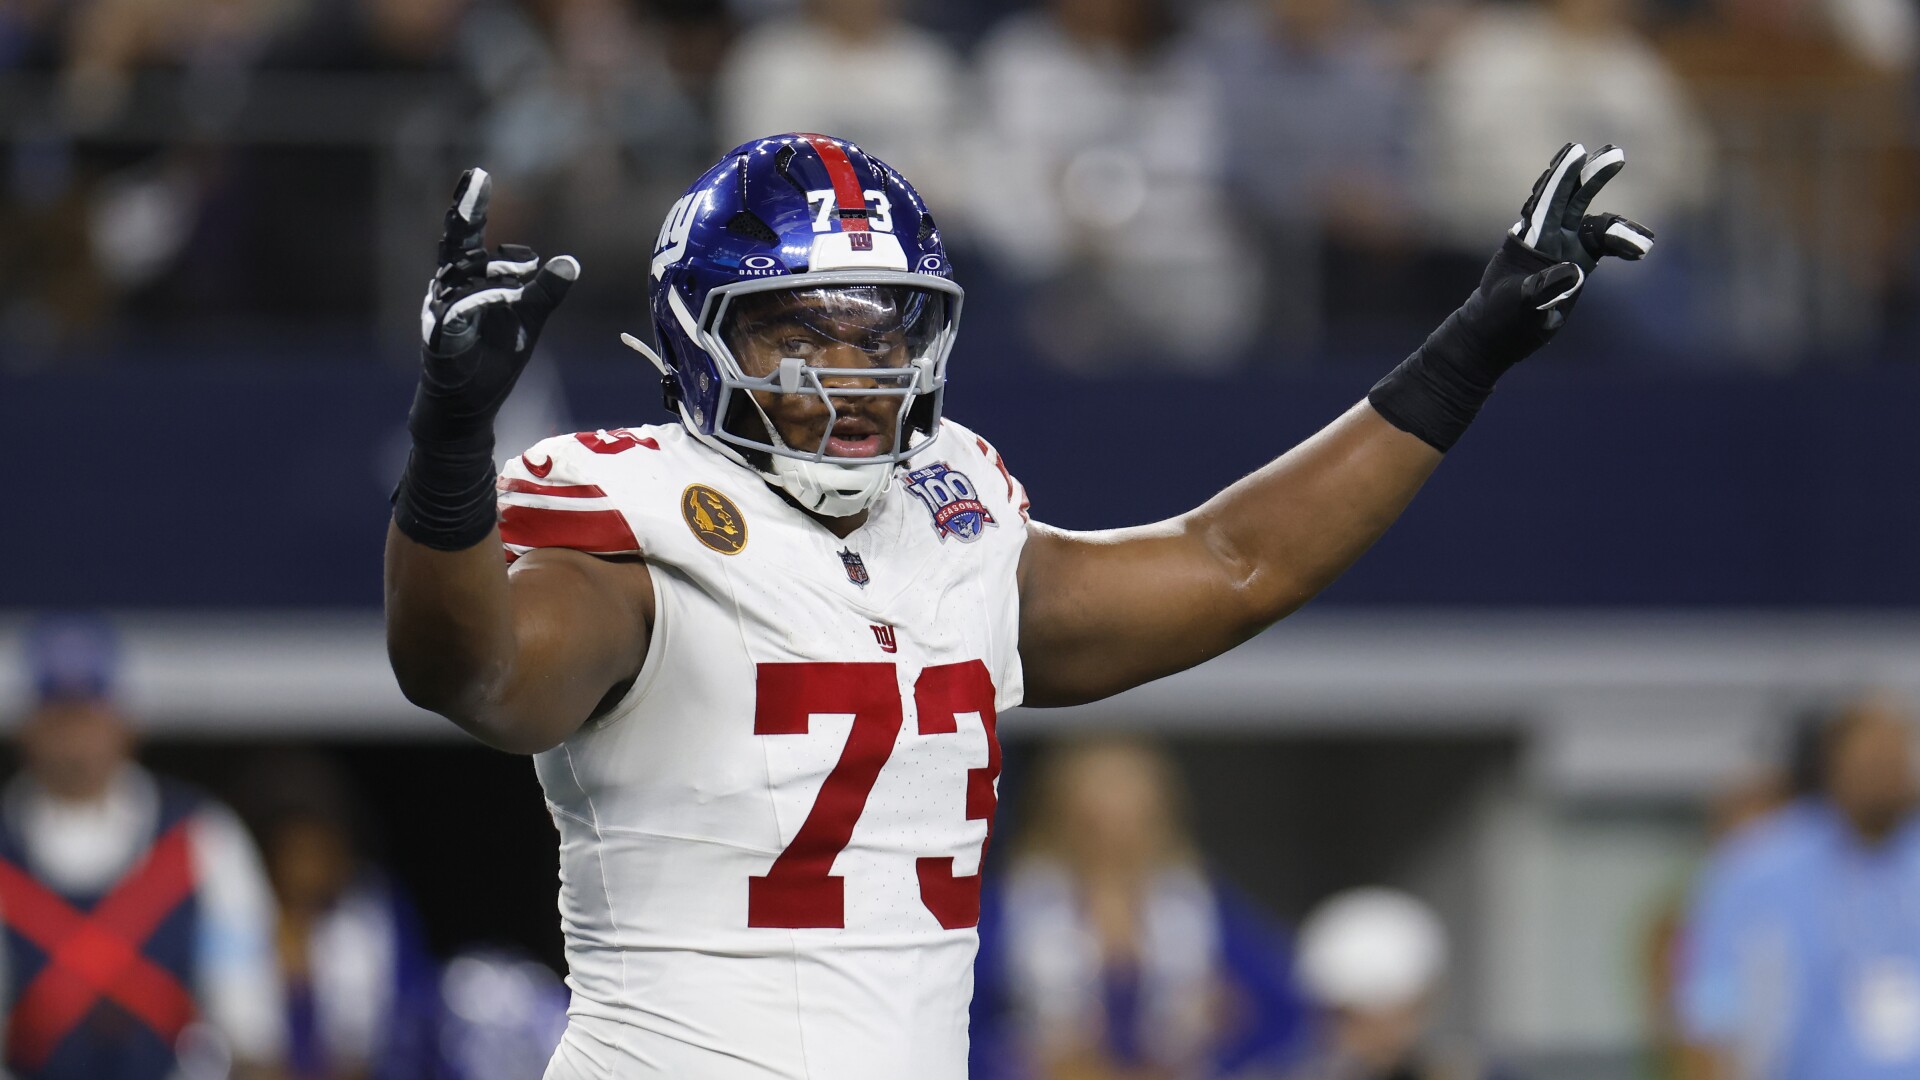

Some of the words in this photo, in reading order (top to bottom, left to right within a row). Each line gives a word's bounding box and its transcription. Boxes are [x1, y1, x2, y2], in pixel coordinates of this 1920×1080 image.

[910, 472, 977, 514] 100
[938, 501, 980, 521] SEASONS
[748, 659, 1002, 930] 73
